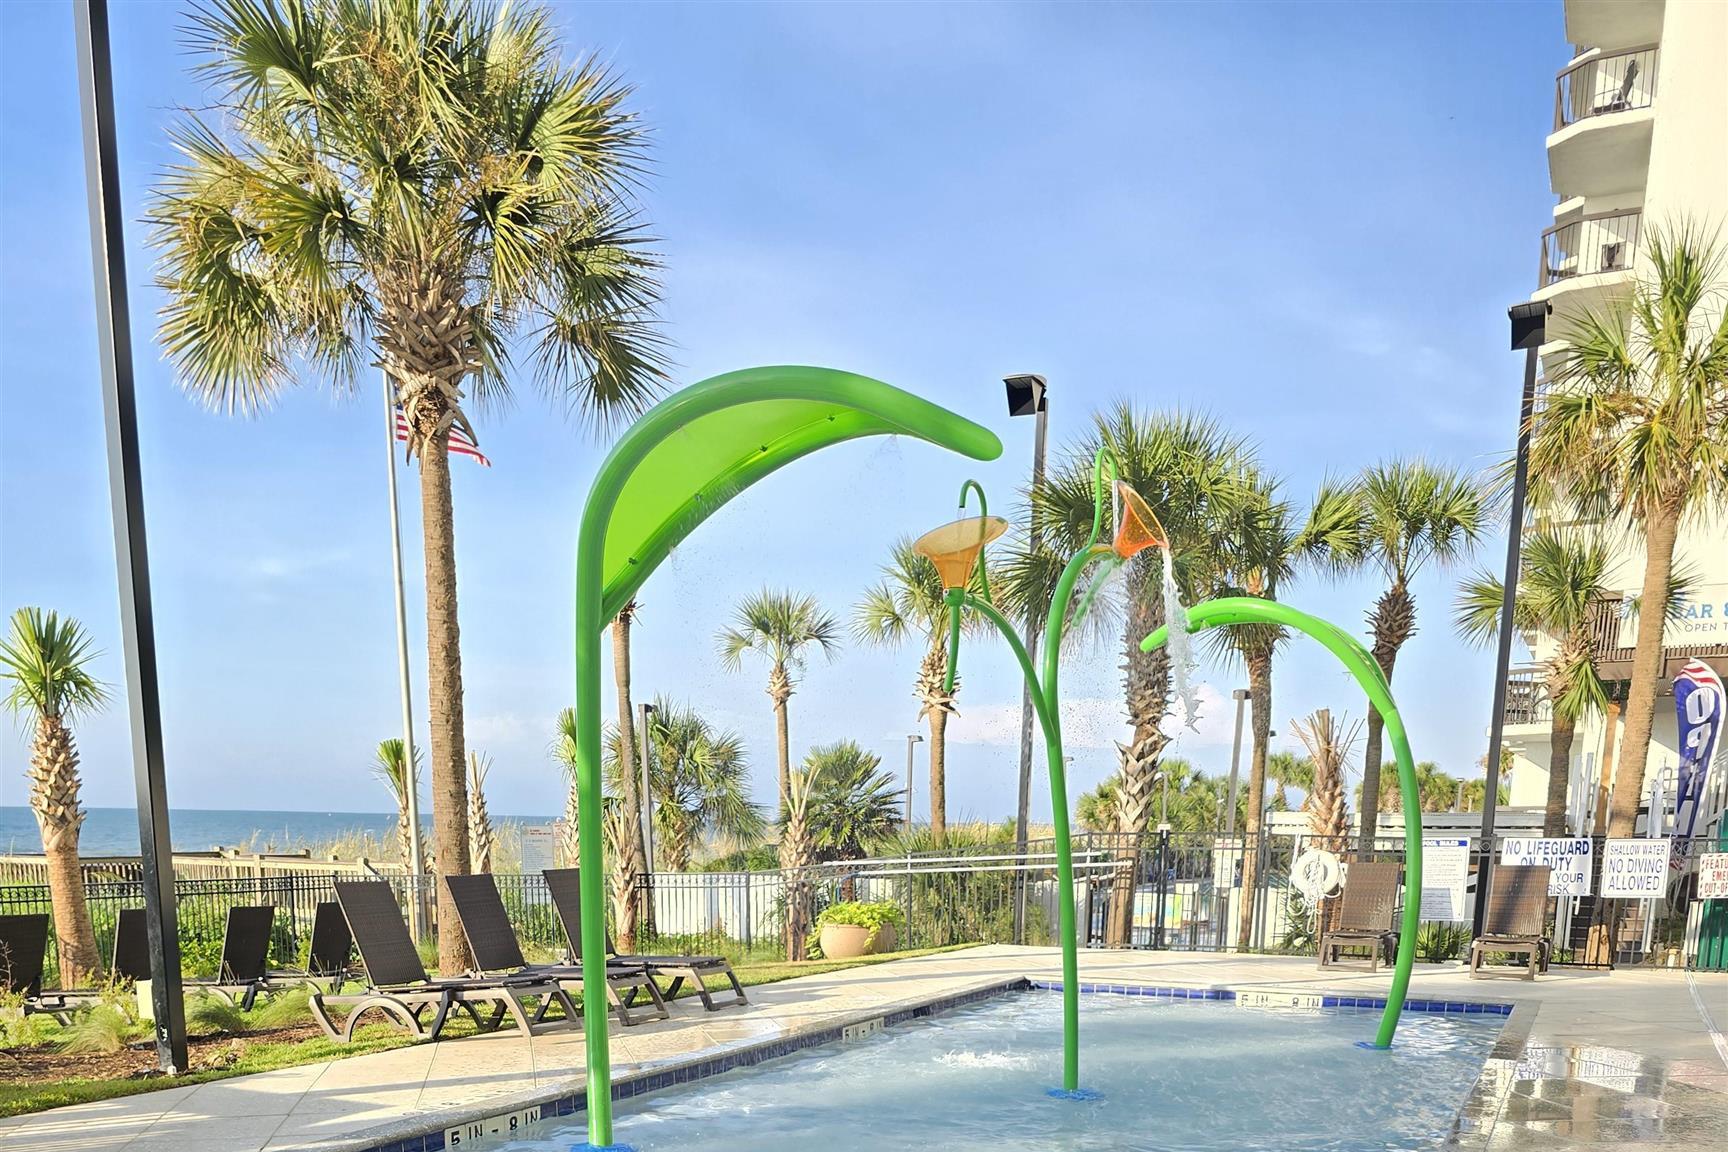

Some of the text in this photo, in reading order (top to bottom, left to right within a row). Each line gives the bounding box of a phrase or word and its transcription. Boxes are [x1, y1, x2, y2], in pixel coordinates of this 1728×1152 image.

[1674, 604, 1712, 618] AR
[1684, 623, 1717, 632] OPEN
[1506, 840, 1590, 855] NO LIFEGUARD
[1610, 845, 1665, 855] SHALLOW WATER
[1542, 857, 1572, 871] DUTY
[1608, 859, 1663, 874] NO DIVING
[1556, 873, 1584, 883] YOUR
[1608, 876, 1660, 890] ALLOWED
